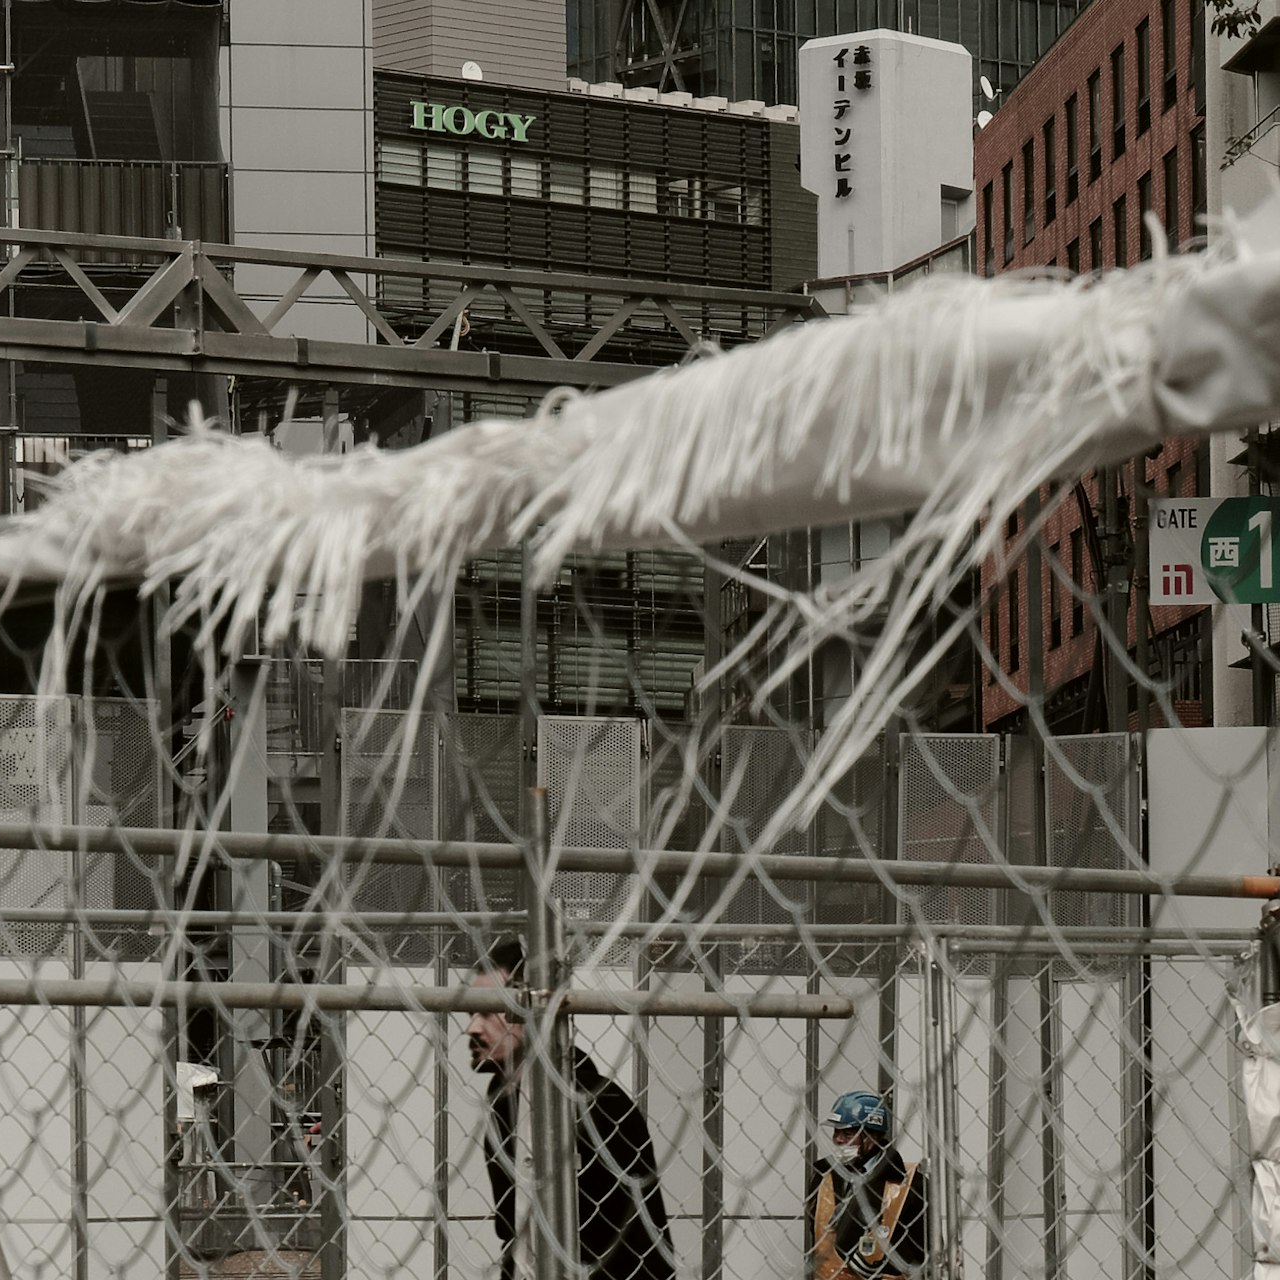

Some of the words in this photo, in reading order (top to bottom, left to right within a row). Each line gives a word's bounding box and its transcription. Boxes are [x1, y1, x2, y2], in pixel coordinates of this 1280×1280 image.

[410, 100, 537, 143] HOGY
[1157, 508, 1197, 529] GATE
[1208, 536, 1240, 568] 西
[1248, 510, 1273, 588] 1
